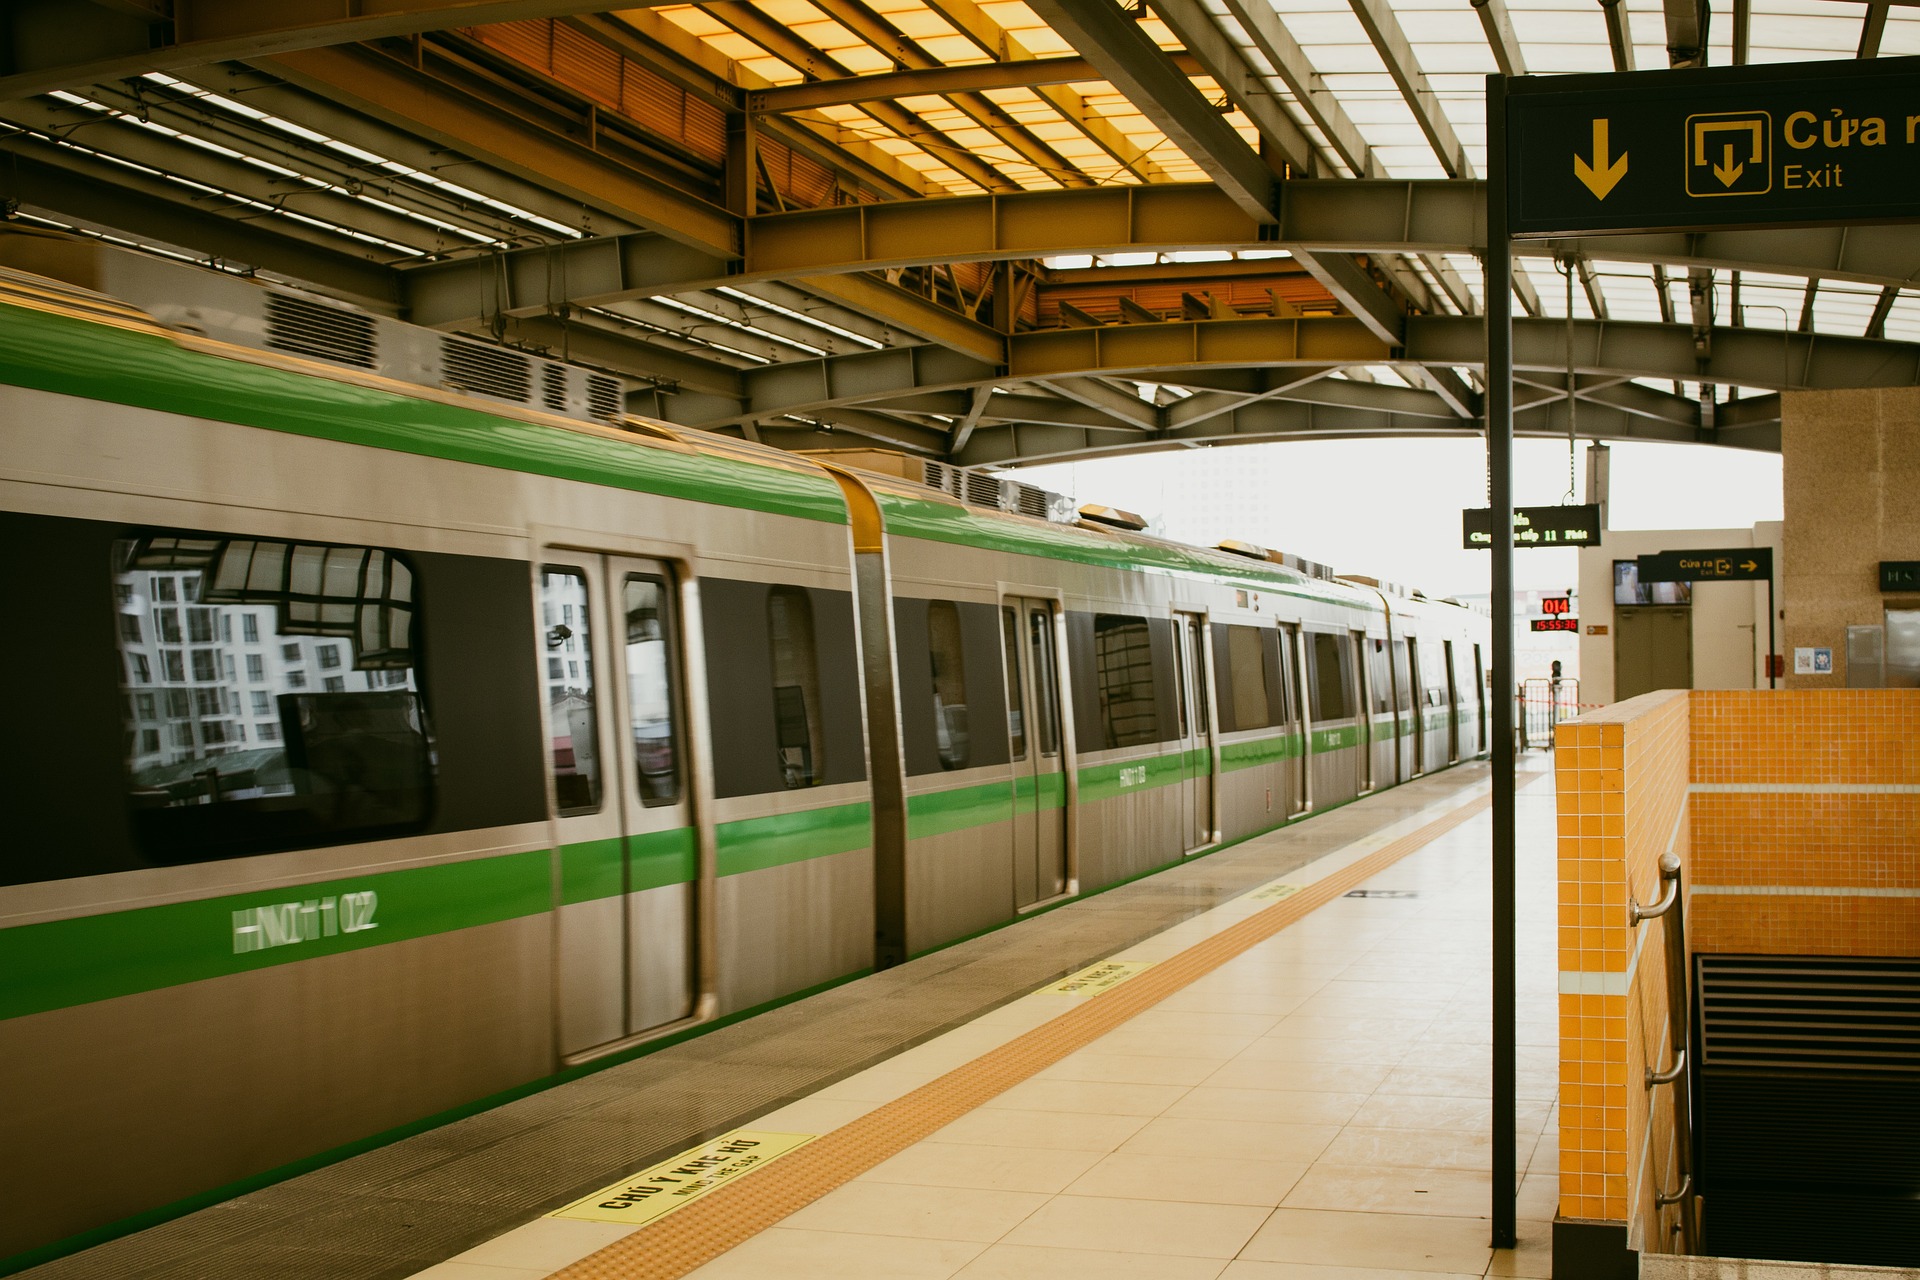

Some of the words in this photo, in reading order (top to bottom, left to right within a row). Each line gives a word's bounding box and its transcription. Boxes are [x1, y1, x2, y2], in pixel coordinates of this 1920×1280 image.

[1784, 108, 1887, 149] Cửa
[1906, 115, 1920, 144] r
[1784, 163, 1843, 189] Exit
[1545, 530, 1557, 541] 11
[1544, 599, 1568, 614] 014
[1536, 619, 1577, 631] 15:55:36
[598, 1186, 664, 1210] CHÚ
[669, 1155, 732, 1175] KHE
[716, 1140, 761, 1153] HỞ
[671, 1180, 714, 1197] MIND
[706, 1168, 740, 1179] THE
[731, 1155, 762, 1168] GAP
